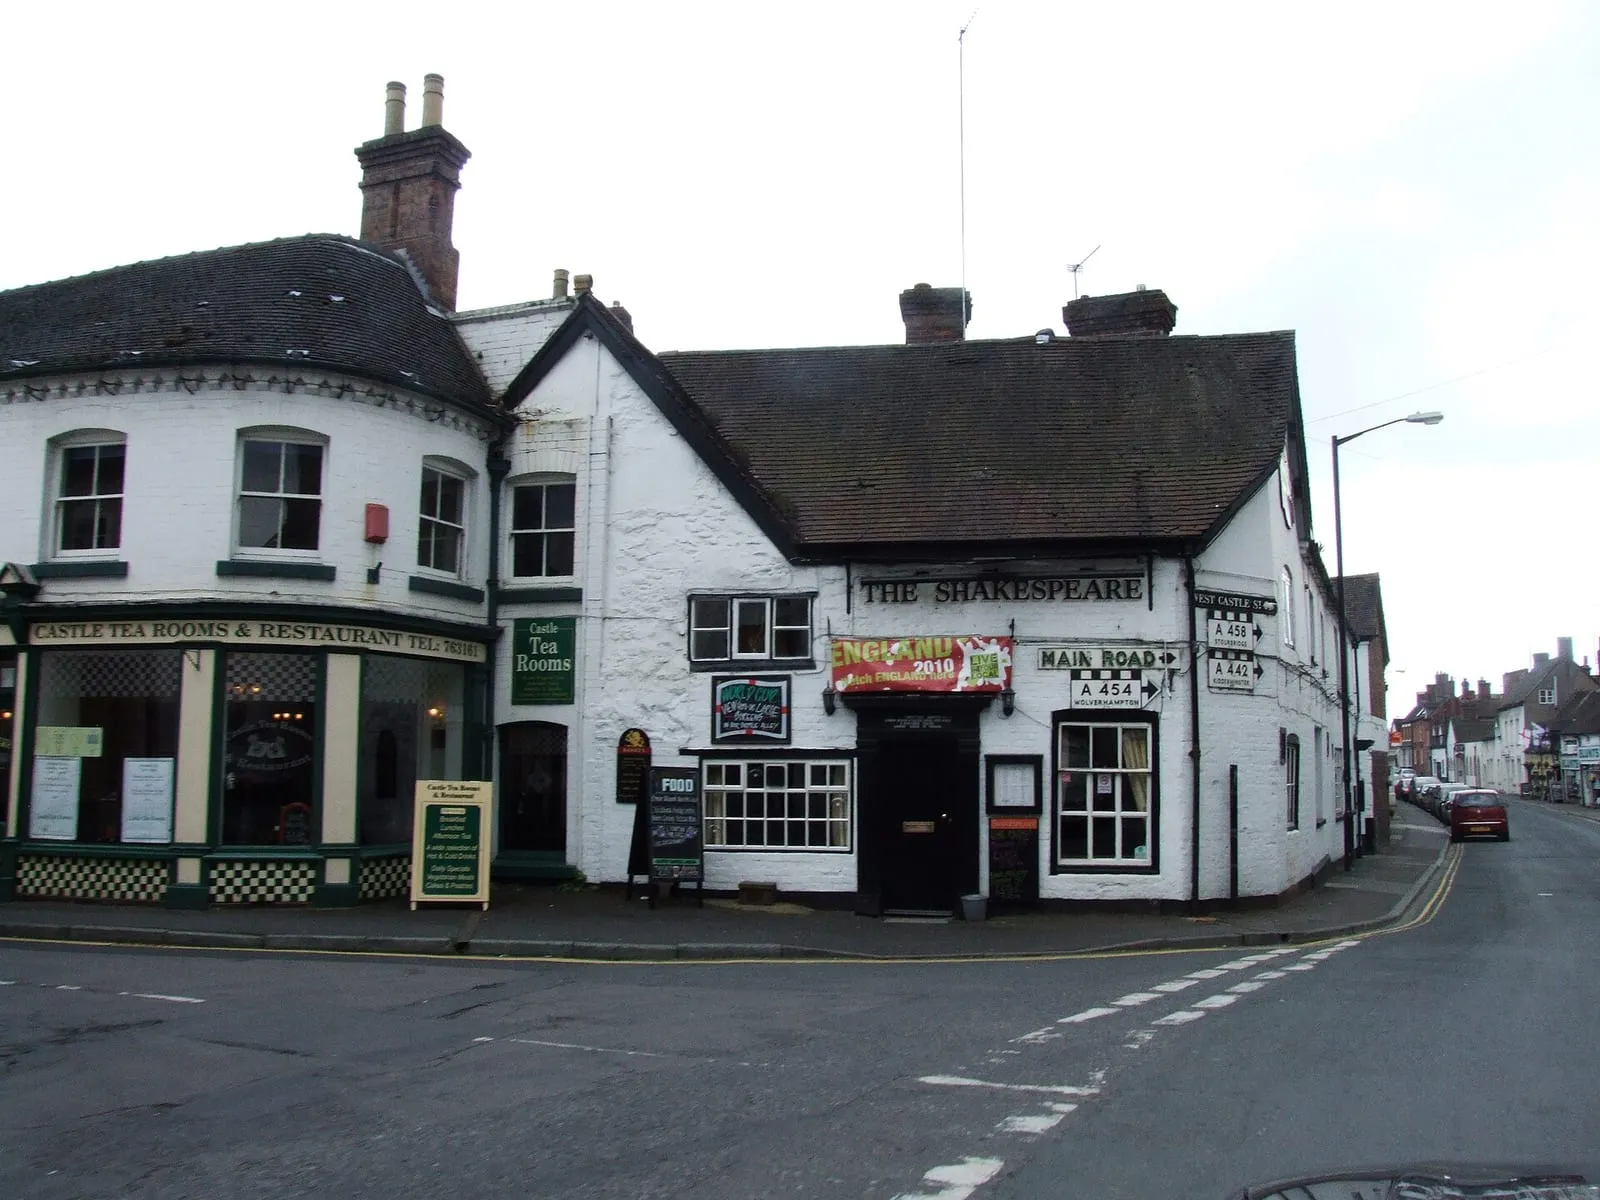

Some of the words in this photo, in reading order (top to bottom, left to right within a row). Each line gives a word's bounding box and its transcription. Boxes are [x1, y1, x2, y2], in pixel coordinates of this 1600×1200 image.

[861, 583, 918, 603] THE
[935, 579, 1143, 603] SHAKESPEARE
[1218, 596, 1251, 608] CASTLE
[34, 623, 103, 639] CASTLE
[105, 623, 145, 638] TEA
[152, 622, 229, 638] ROOMS
[235, 622, 251, 638] &
[258, 623, 403, 647] RESTAURANT
[529, 621, 559, 634] Castle
[1215, 623, 1223, 635] A
[1227, 624, 1247, 637] 458
[529, 636, 559, 655] Tea
[832, 636, 953, 668] ENGLAND
[516, 654, 572, 672] Rooms
[970, 652, 998, 666] LIVE
[1041, 651, 1093, 667] MAIN
[1101, 650, 1156, 667] ROAD
[913, 658, 955, 675] 2010
[1215, 662, 1223, 675] A
[1226, 663, 1248, 677] 442
[875, 671, 927, 683] ENGLAND
[1081, 683, 1092, 696] A
[1099, 683, 1132, 696] 454
[662, 778, 694, 792] FOOD
